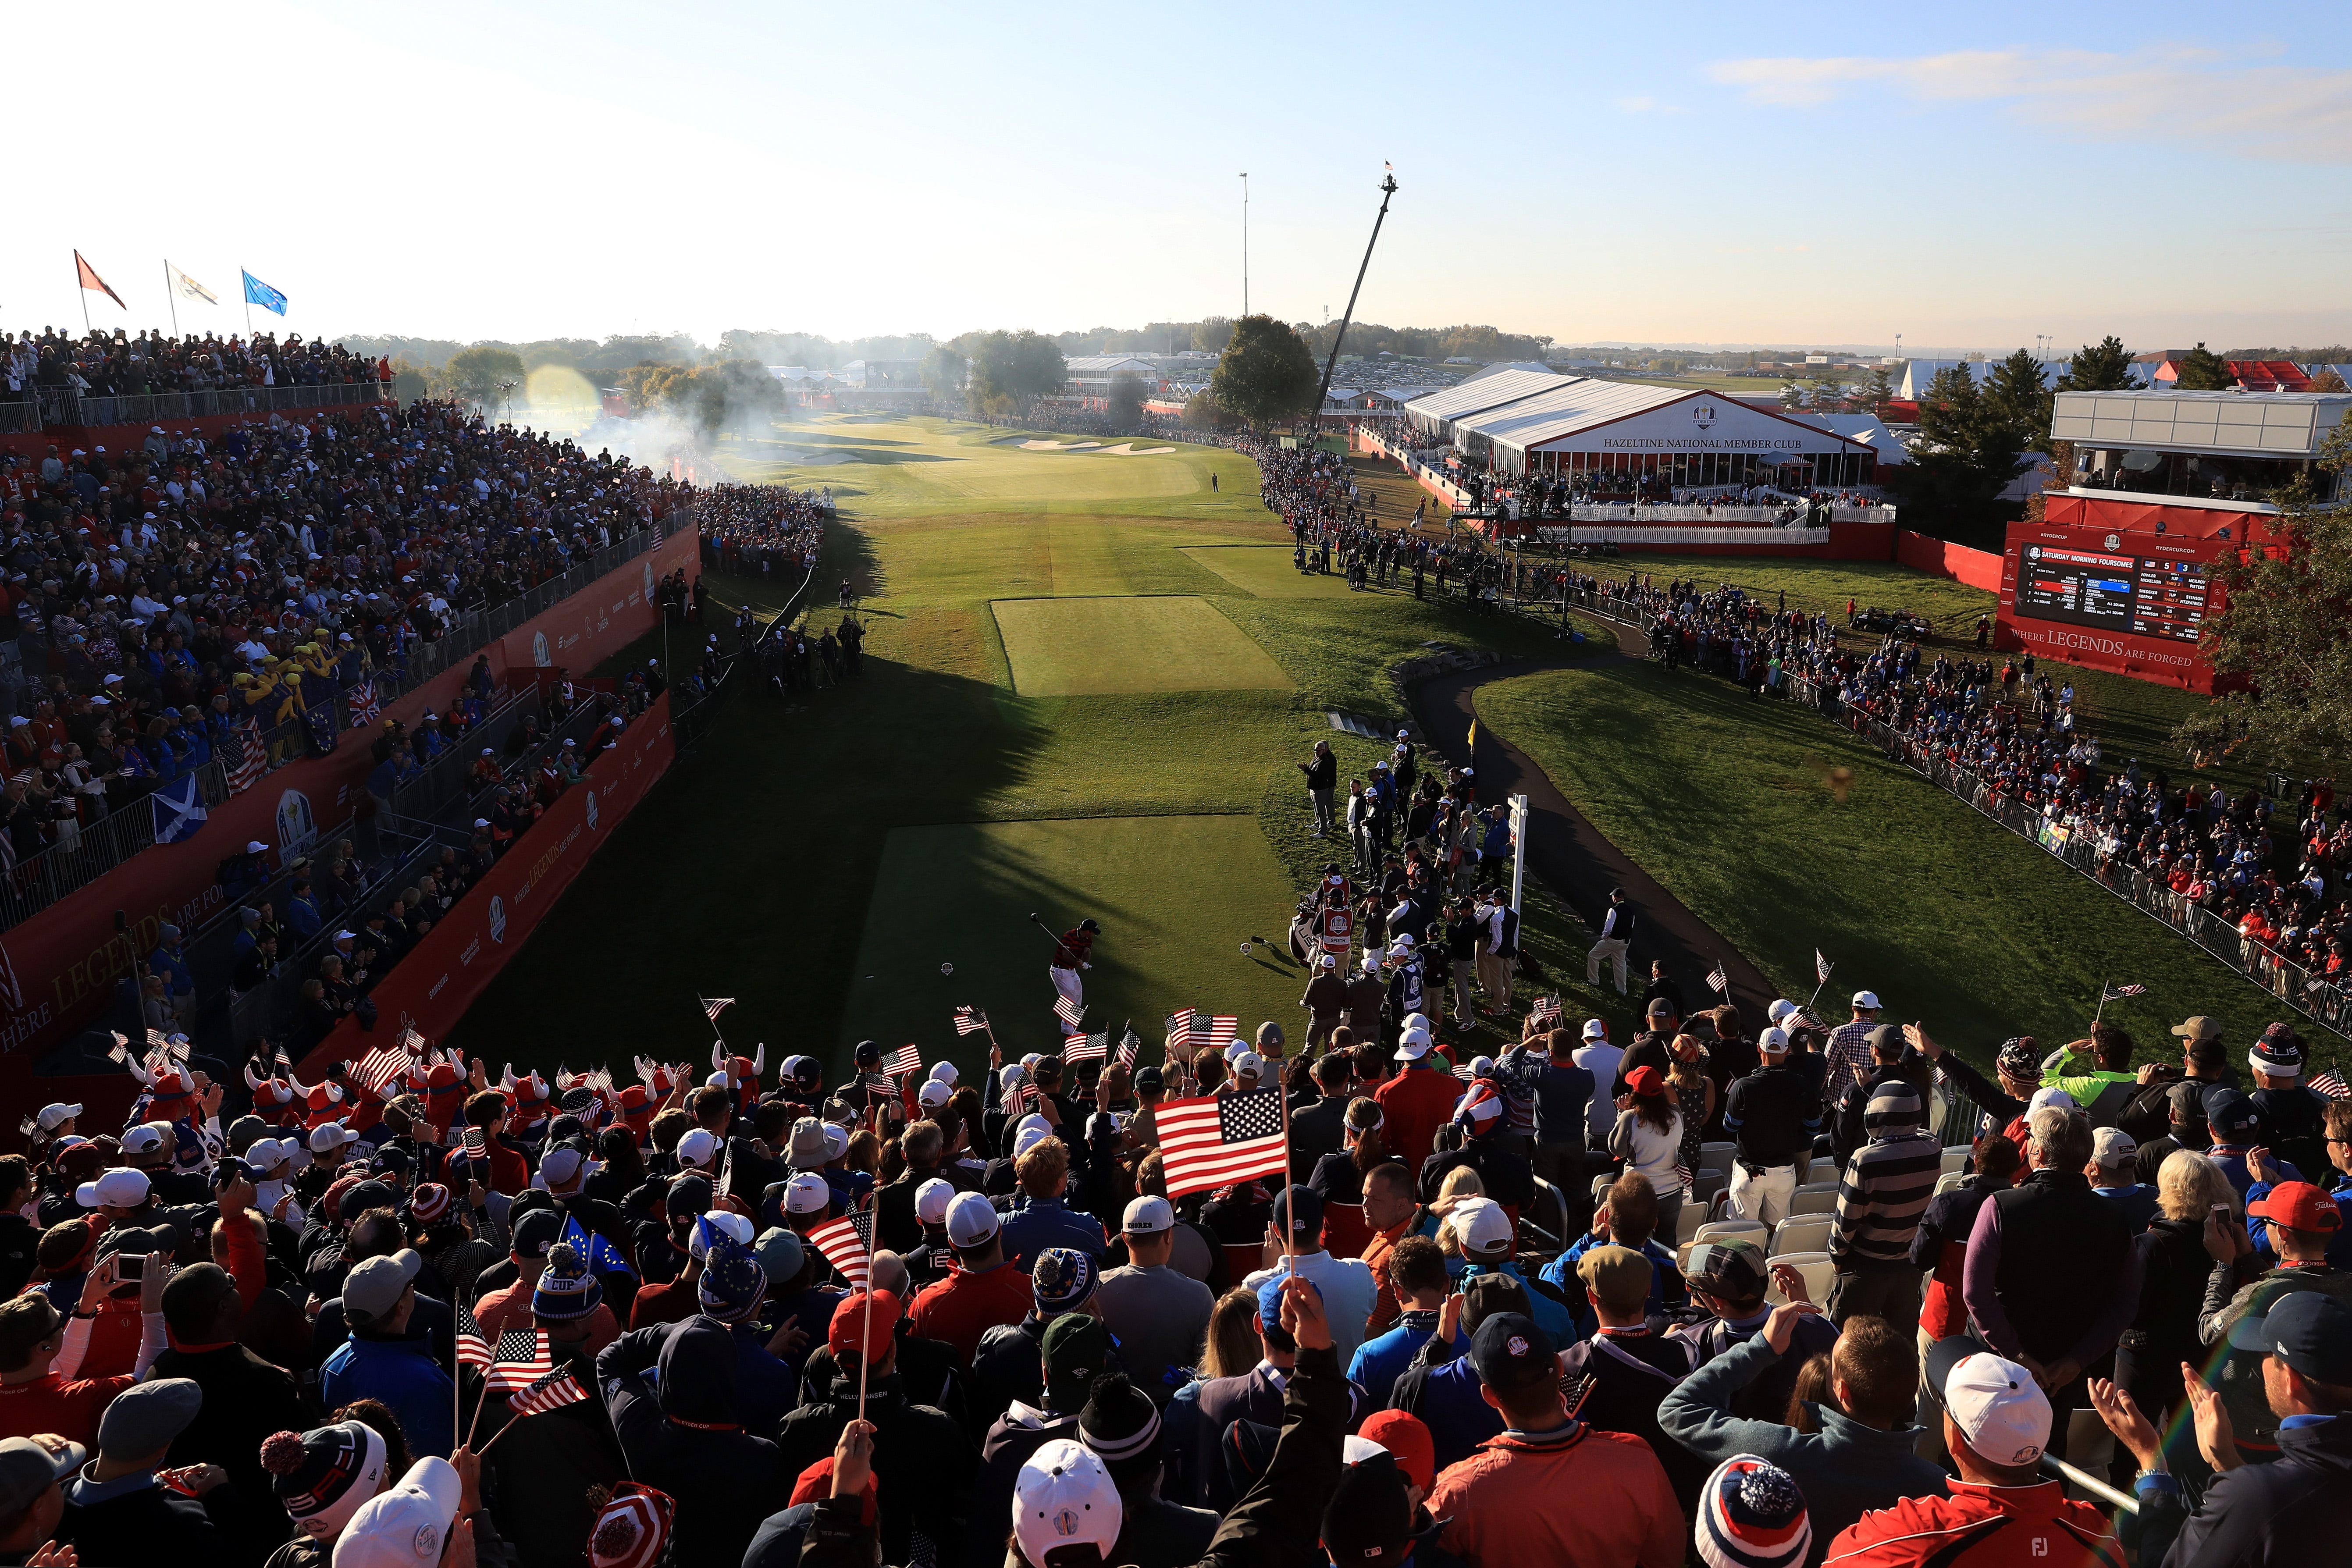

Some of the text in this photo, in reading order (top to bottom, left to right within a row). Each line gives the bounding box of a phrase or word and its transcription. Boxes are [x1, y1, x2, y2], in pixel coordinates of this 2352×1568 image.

[1604, 438, 1802, 449] HAZELTINE NATIONAL MEMBER CLUB
[2156, 545, 2195, 554] RYDERCUP.COM
[2041, 551, 2133, 569] SATURDAY MORNING FOURSOMES
[598, 618, 609, 632] OMEGA
[2011, 629, 2192, 667] WHERE LEGENDS ARE FORGED
[514, 823, 581, 905] WHERE LEGENDS ARE FORGED
[176, 897, 201, 927] ARE
[428, 973, 448, 1000] SAMSUNG
[396, 1017, 416, 1045] OMEGA
[2315, 1201, 2337, 1210] Titleist
[970, 1233, 989, 1242] Titleist
[552, 1280, 575, 1291] CUP
[865, 1391, 888, 1400] ANSEN
[2031, 1537, 2048, 1557] FJ
